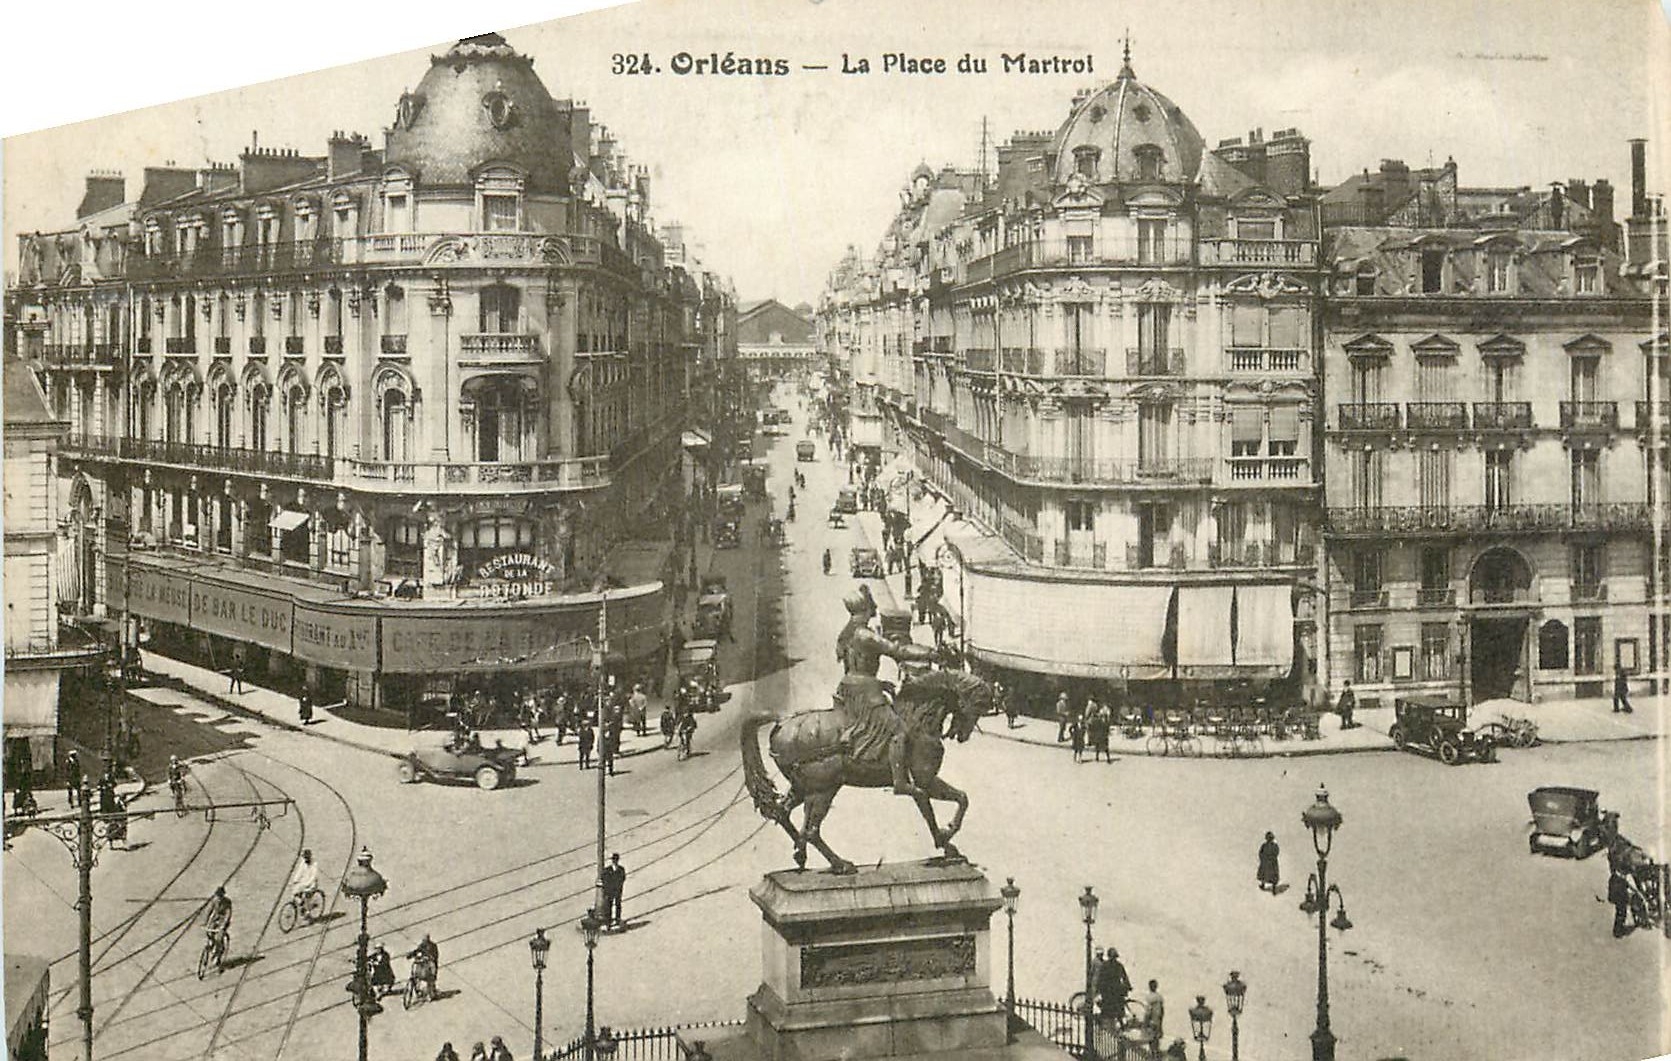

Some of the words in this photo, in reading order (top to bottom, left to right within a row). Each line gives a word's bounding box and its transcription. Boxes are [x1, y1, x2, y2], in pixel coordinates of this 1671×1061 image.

[478, 553, 555, 579] RESTAURANT
[504, 569, 515, 578] DE
[517, 568, 528, 577] LA
[479, 581, 554, 598] ROTONDE
[193, 593, 209, 614] DE
[212, 597, 237, 621] BAR
[241, 602, 256, 626] LE
[260, 607, 288, 633] DUC
